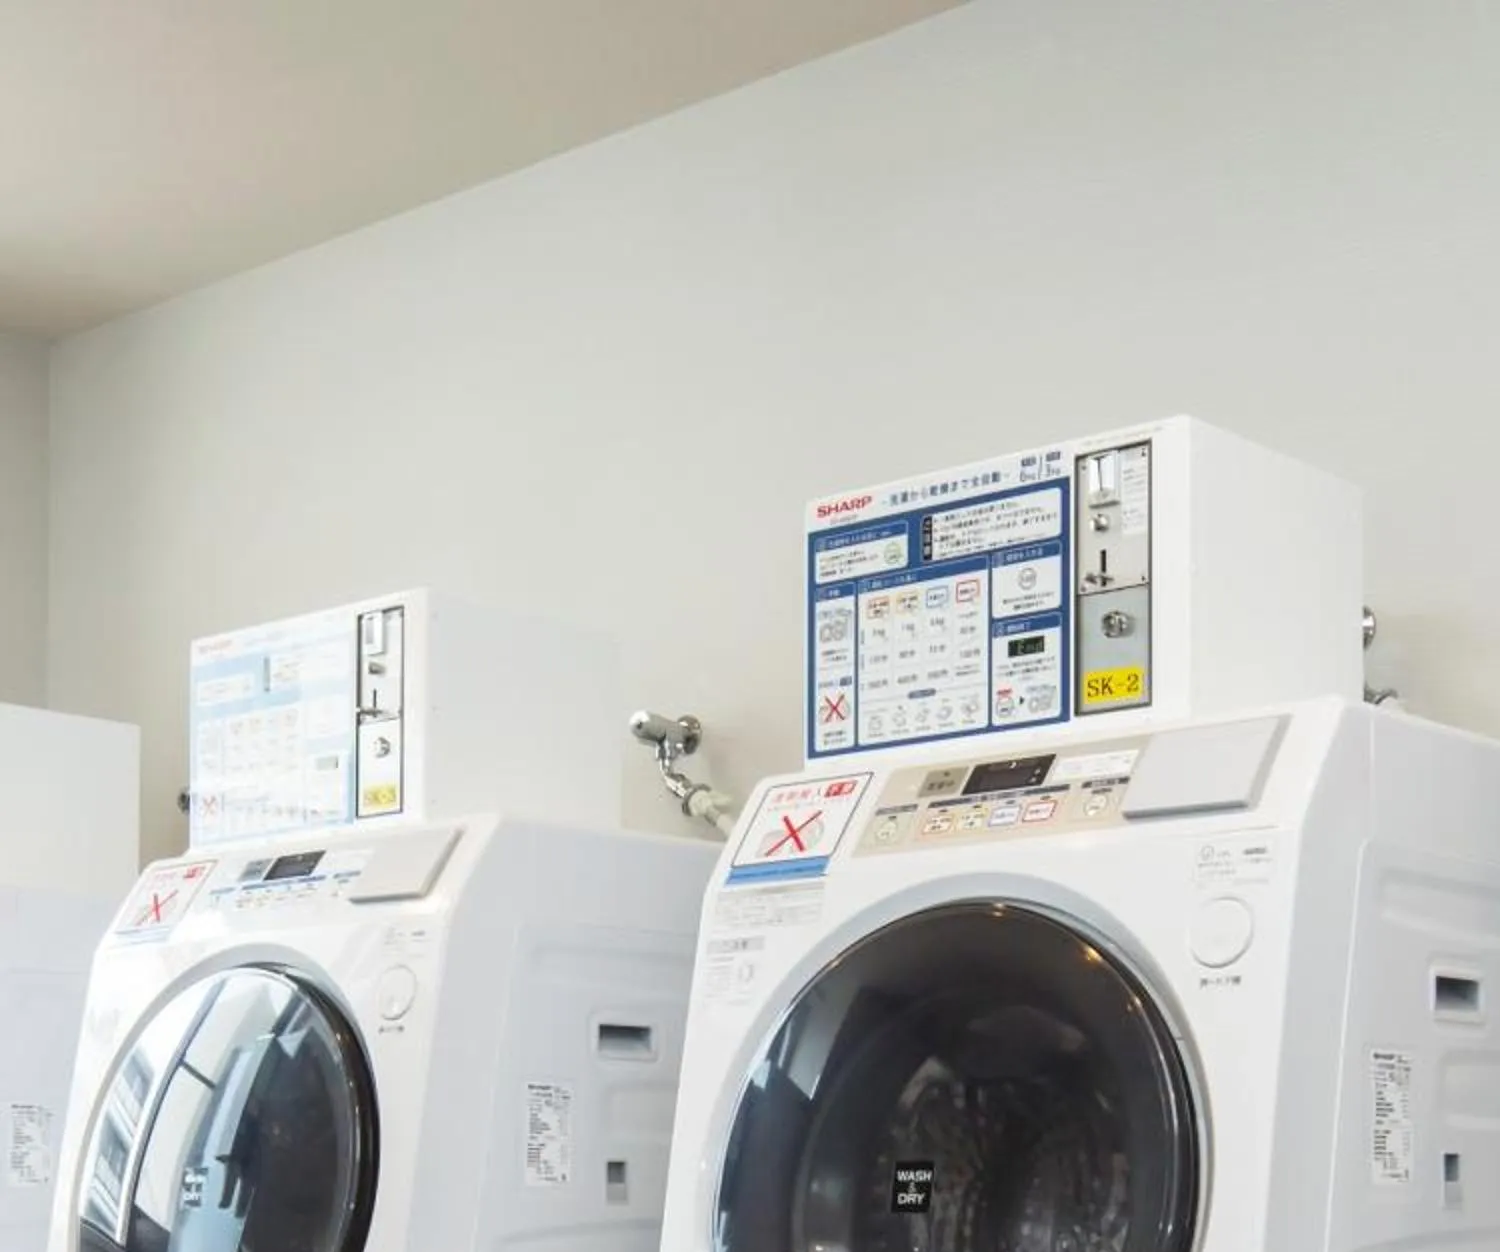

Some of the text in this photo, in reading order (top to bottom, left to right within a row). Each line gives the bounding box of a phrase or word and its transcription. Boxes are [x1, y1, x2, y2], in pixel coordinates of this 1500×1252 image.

[816, 495, 873, 519] SHARP
[1087, 674, 1139, 698] SK-2
[897, 1169, 933, 1182] WASH
[897, 1193, 926, 1205] DRY
